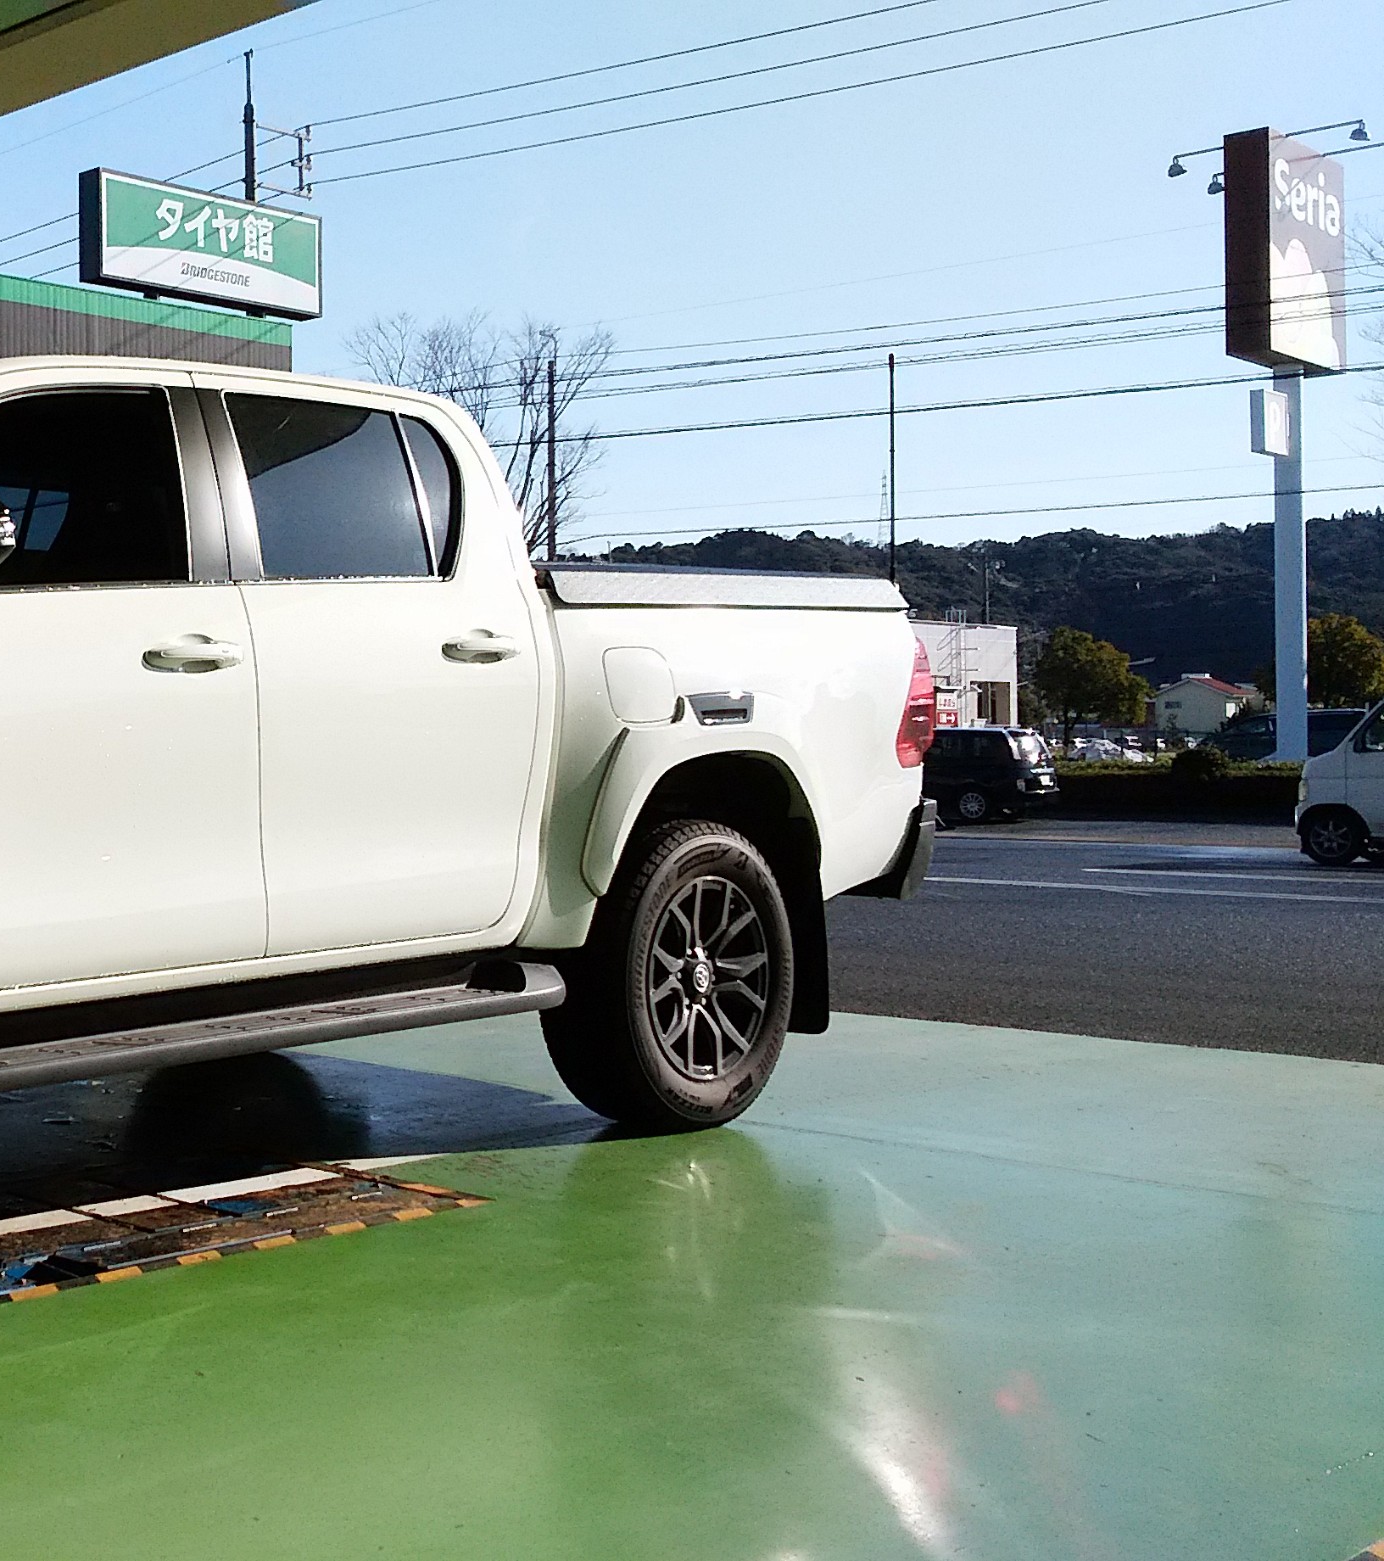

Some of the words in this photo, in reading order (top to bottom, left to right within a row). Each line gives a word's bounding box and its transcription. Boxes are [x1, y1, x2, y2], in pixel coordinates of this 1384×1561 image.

[1274, 158, 1341, 237] Seria
[155, 198, 275, 263] タイヤ館
[180, 262, 251, 287] BRIDGESTONE
[1269, 401, 1281, 444] P
